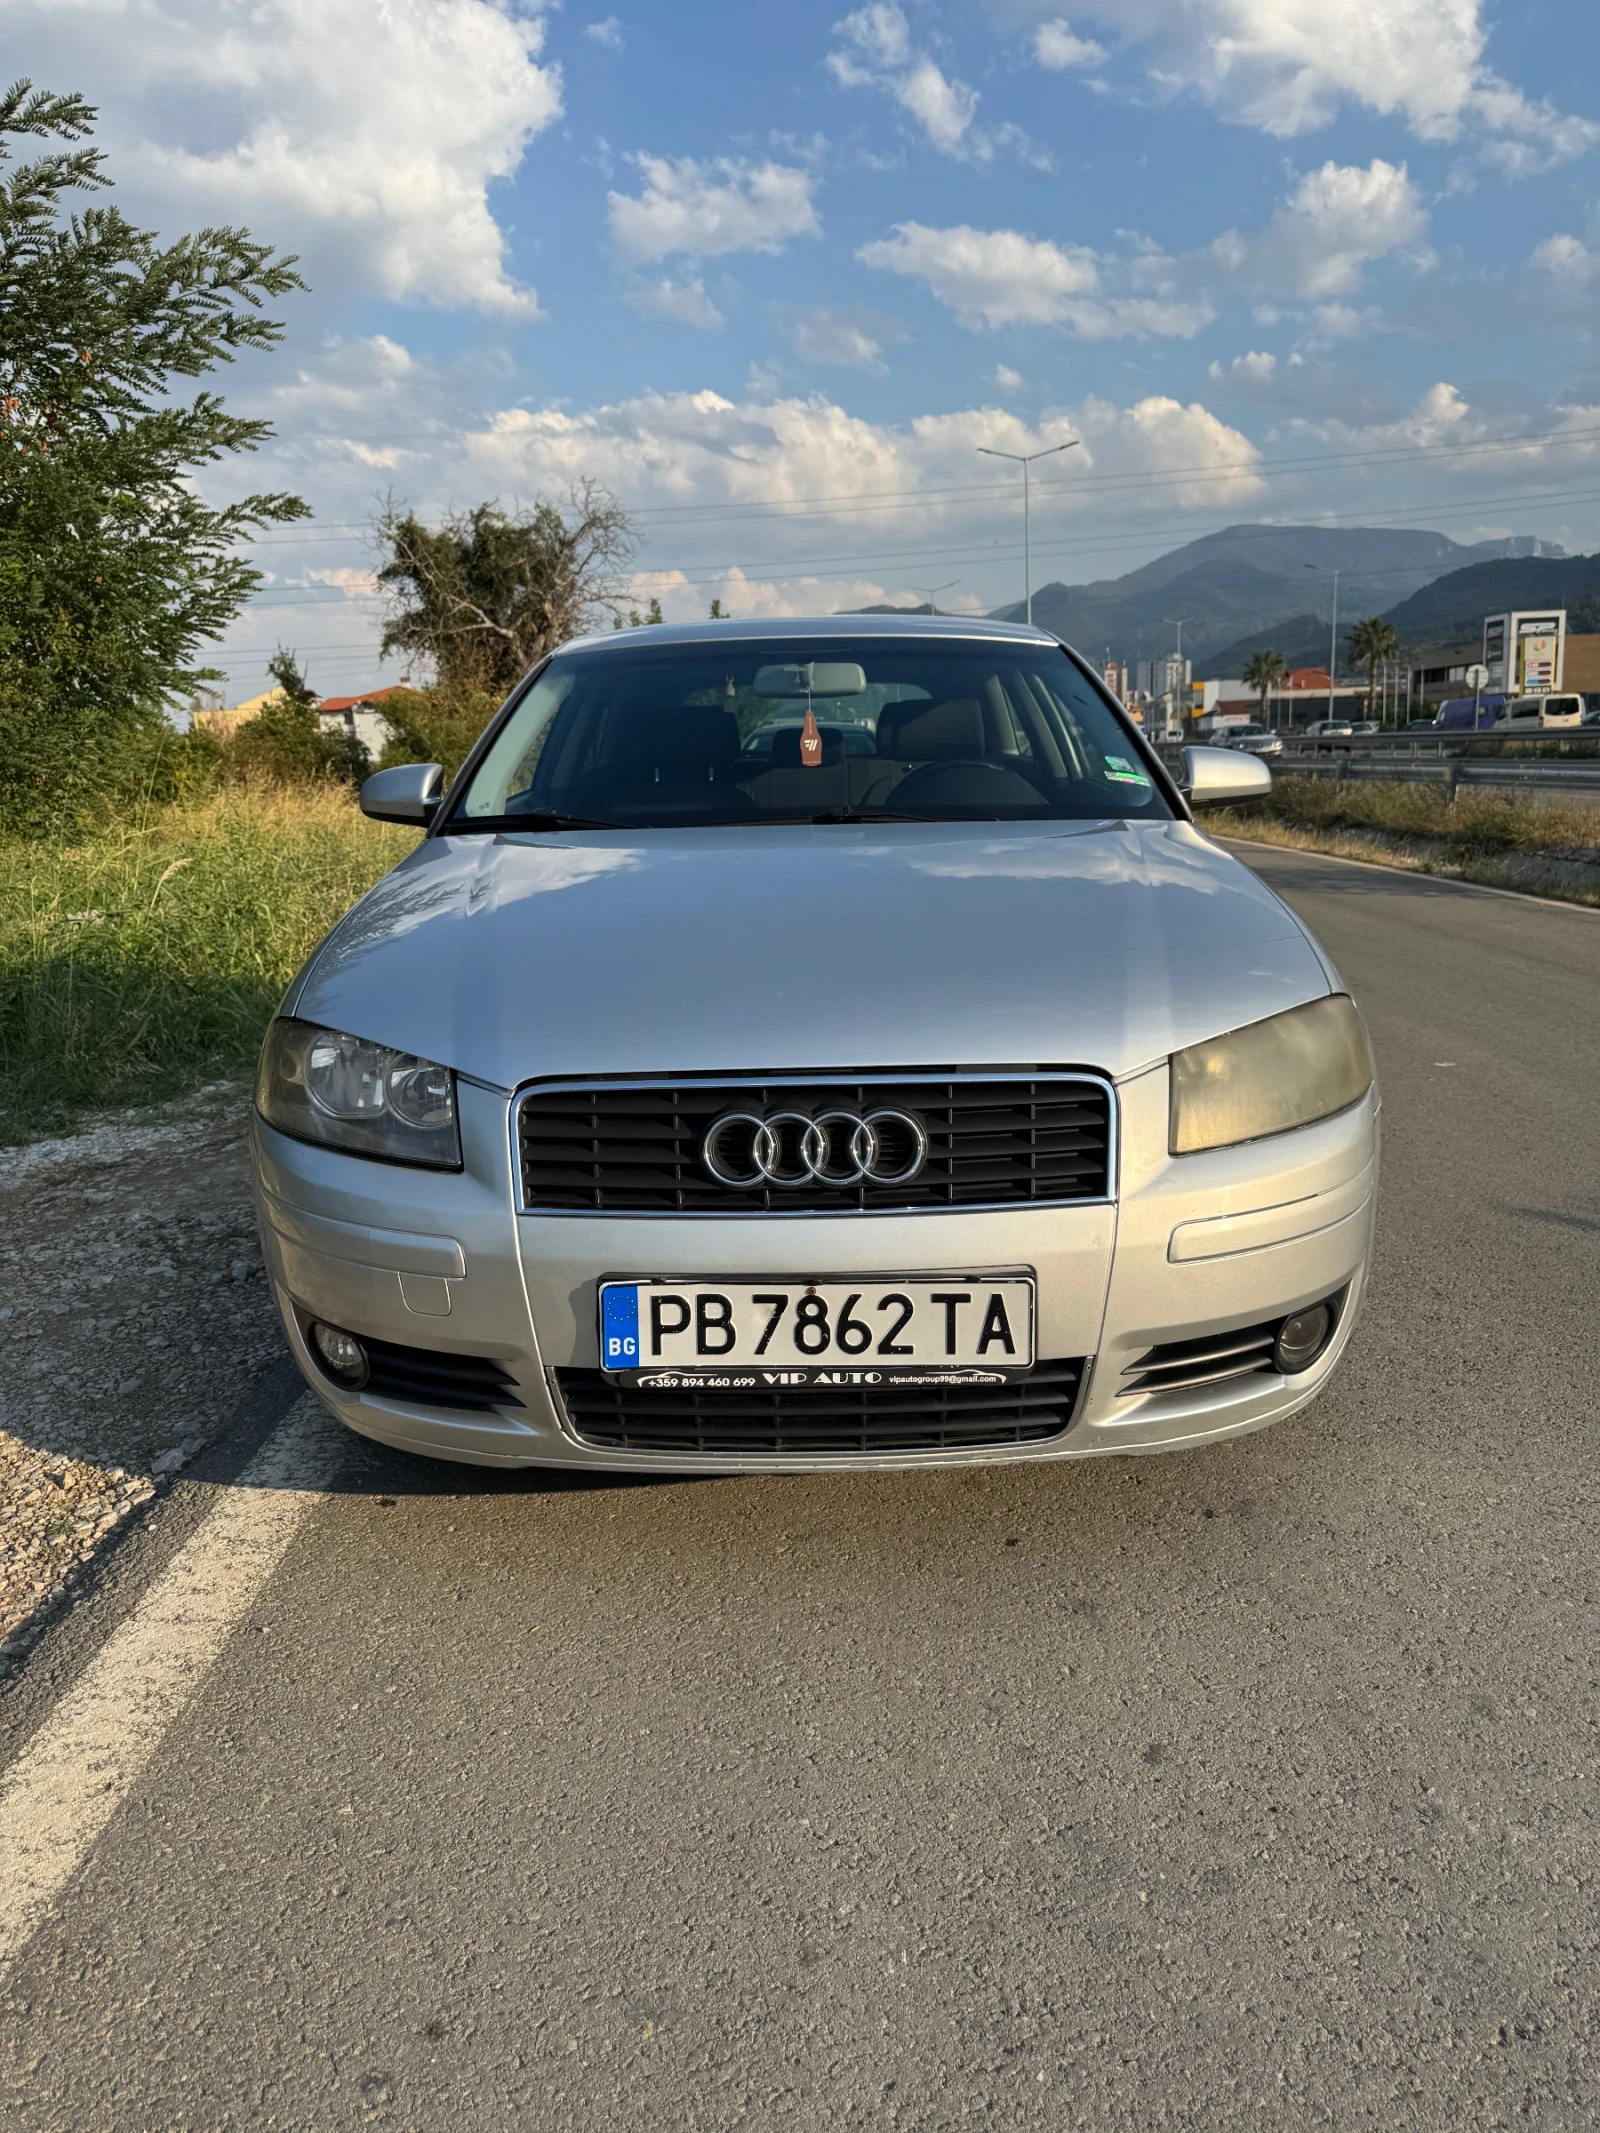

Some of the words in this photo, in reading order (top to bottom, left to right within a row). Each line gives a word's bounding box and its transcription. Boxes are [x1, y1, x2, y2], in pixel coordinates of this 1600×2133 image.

[650, 1293, 737, 1355] PB
[752, 1293, 914, 1355] 7862
[931, 1293, 1016, 1355] TA
[608, 1337, 636, 1356] BG
[648, 1378, 679, 1387] +359
[682, 1378, 704, 1387] 894
[708, 1377, 731, 1387] 460
[733, 1377, 757, 1387] 699
[762, 1372, 807, 1384] VIP
[813, 1372, 882, 1384] AUTO
[889, 1375, 997, 1384] vipautogroup99@gmail.com
